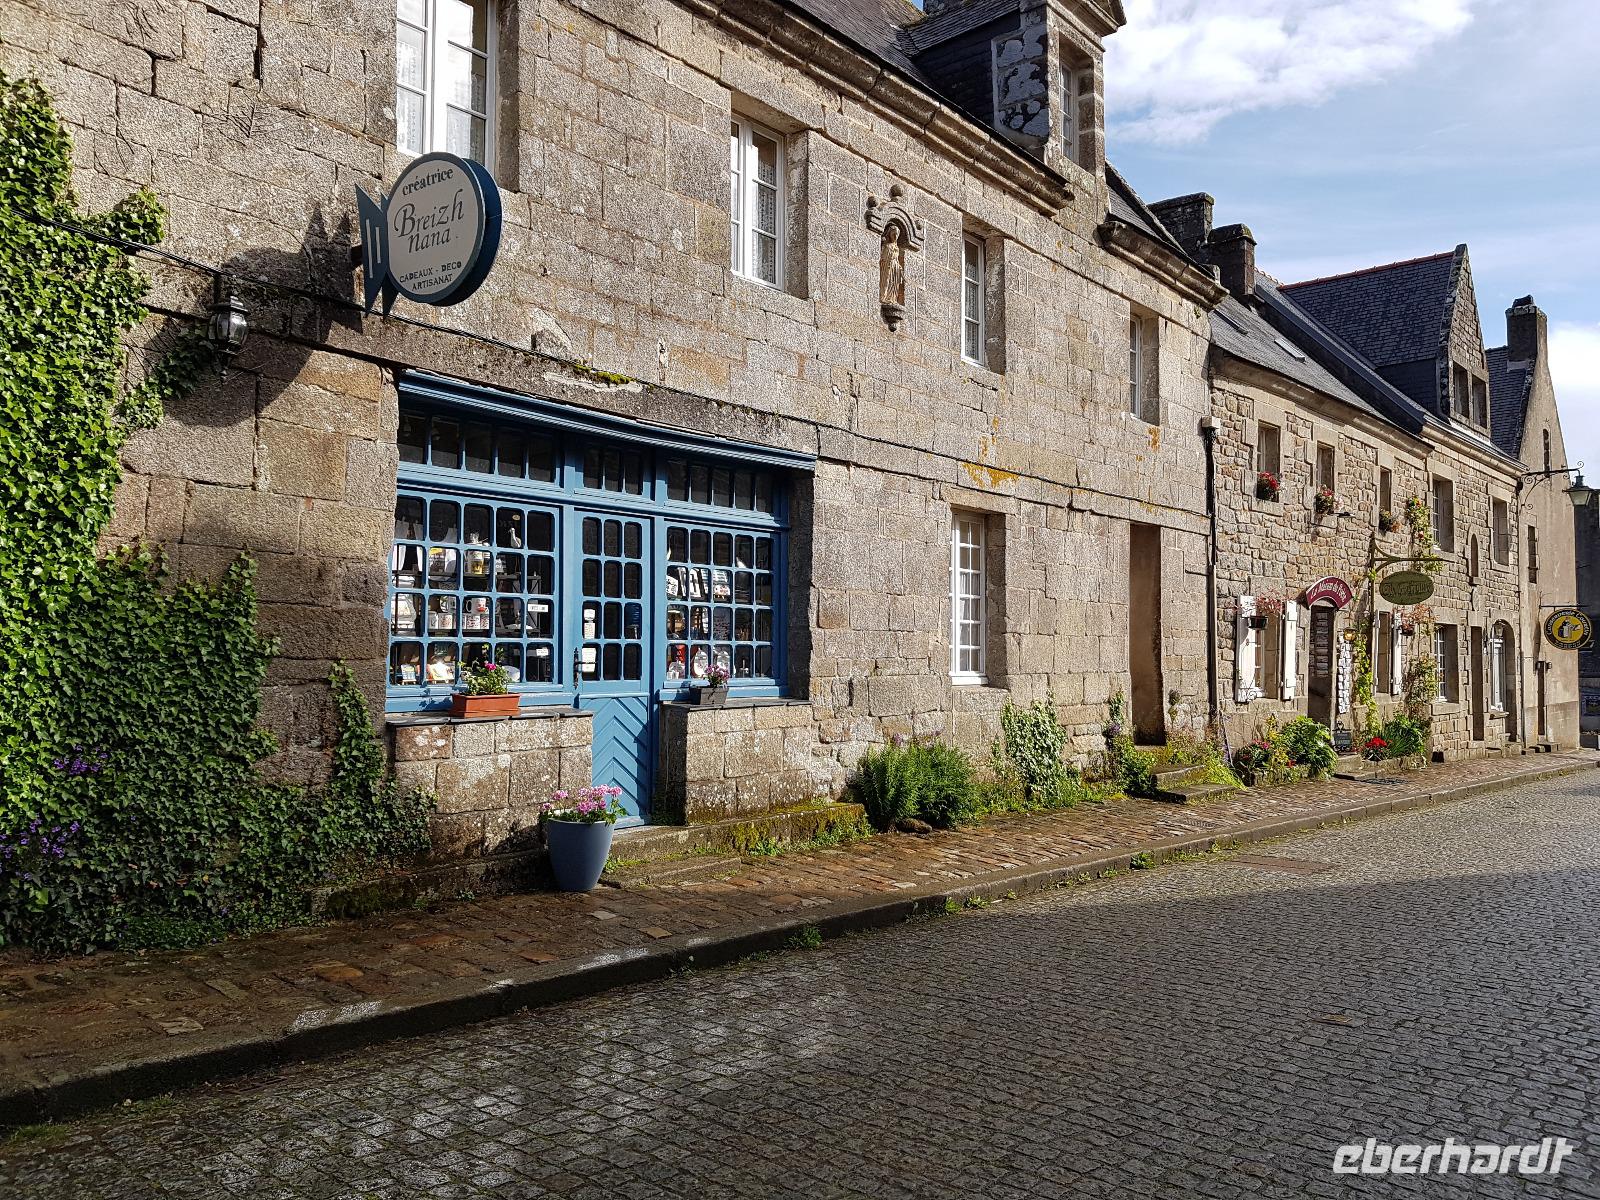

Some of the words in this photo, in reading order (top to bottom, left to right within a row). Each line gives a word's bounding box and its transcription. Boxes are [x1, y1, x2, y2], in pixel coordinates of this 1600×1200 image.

[402, 168, 454, 196] créatrice
[393, 188, 464, 238] Breizh
[399, 267, 433, 283] CADEAUX
[412, 273, 453, 291] ARTISANAT
